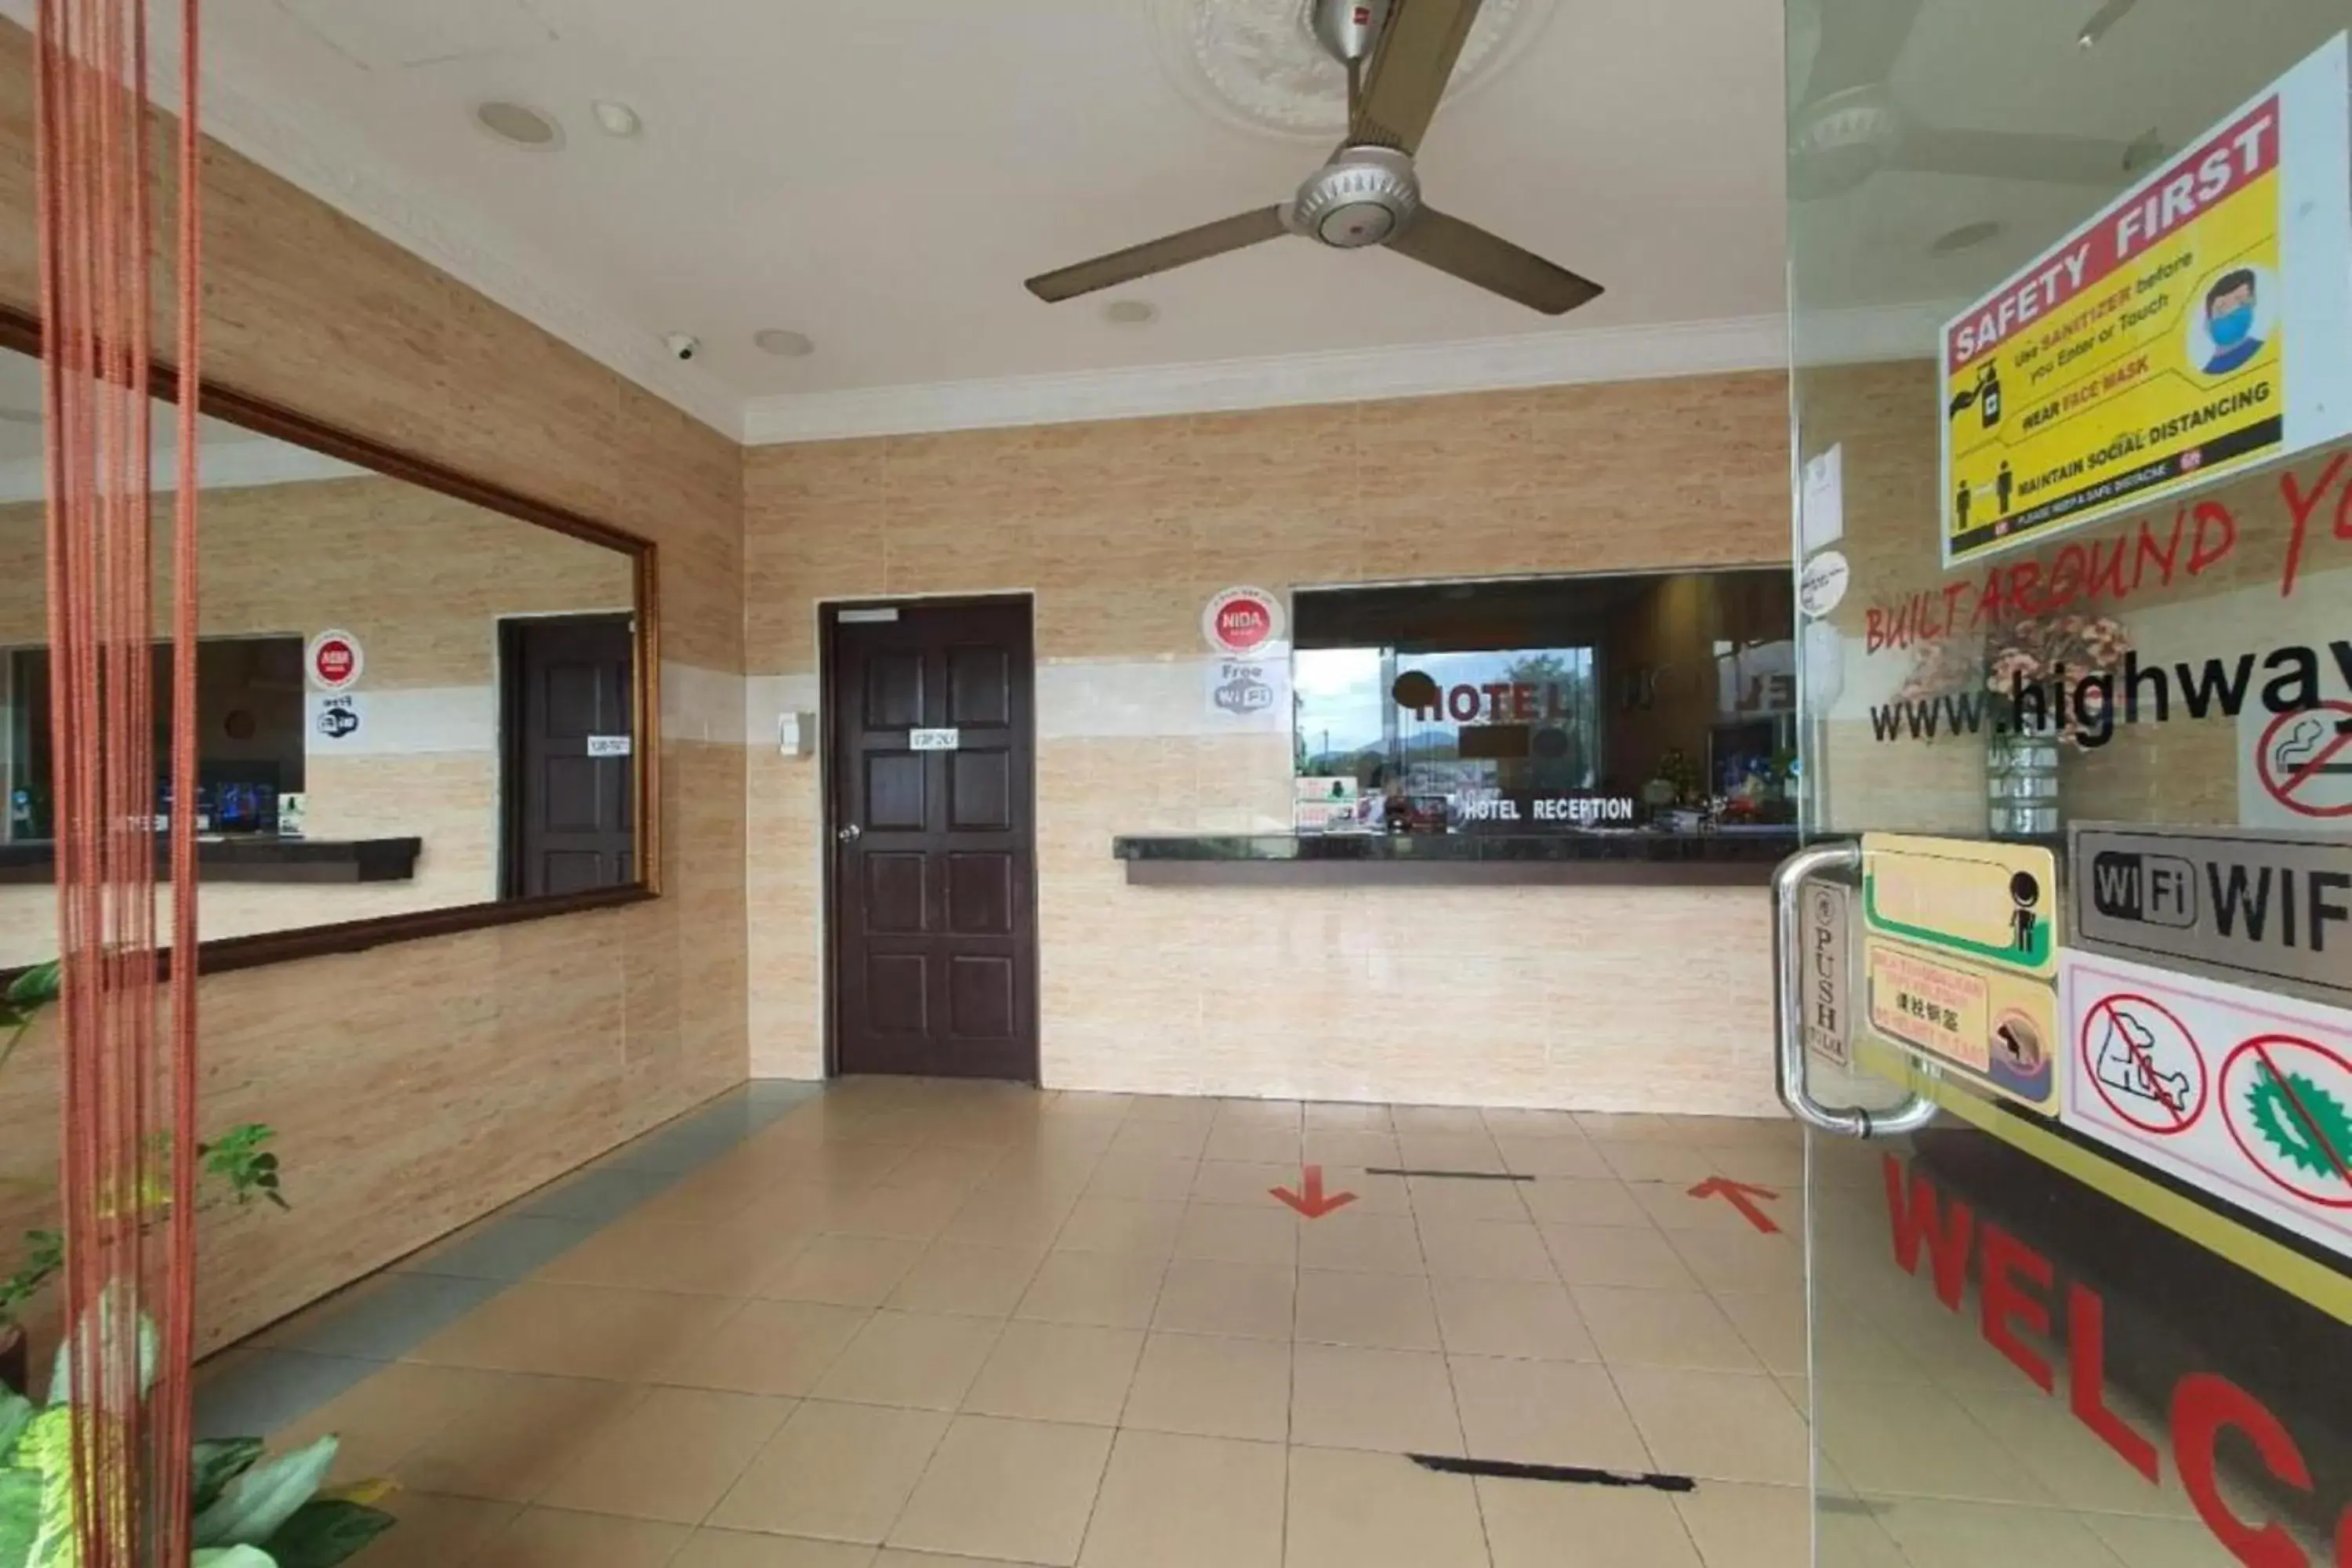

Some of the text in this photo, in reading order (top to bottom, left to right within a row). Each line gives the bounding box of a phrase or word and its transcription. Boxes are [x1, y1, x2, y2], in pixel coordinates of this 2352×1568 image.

[1955, 115, 2272, 362] SAFETY FIRST
[2014, 252, 2193, 368] Use SANITIZER before
[2031, 293, 2169, 386] you Enter or Touch
[2018, 458, 2085, 497] MAINTAIN
[2087, 434, 2145, 472] SOCIAL
[2148, 381, 2270, 447] DISTANCING
[2022, 354, 2150, 431] WEAR FACE MASK
[1222, 611, 1265, 628] NIDA
[1864, 580, 1972, 655] BUILT
[1971, 499, 2239, 625] AROUND
[1221, 664, 1263, 679] Free
[1465, 797, 1633, 820] HOTEL RECEPTION
[1815, 926, 1837, 1033] PUSH
[1884, 1149, 2352, 1568] WELC
